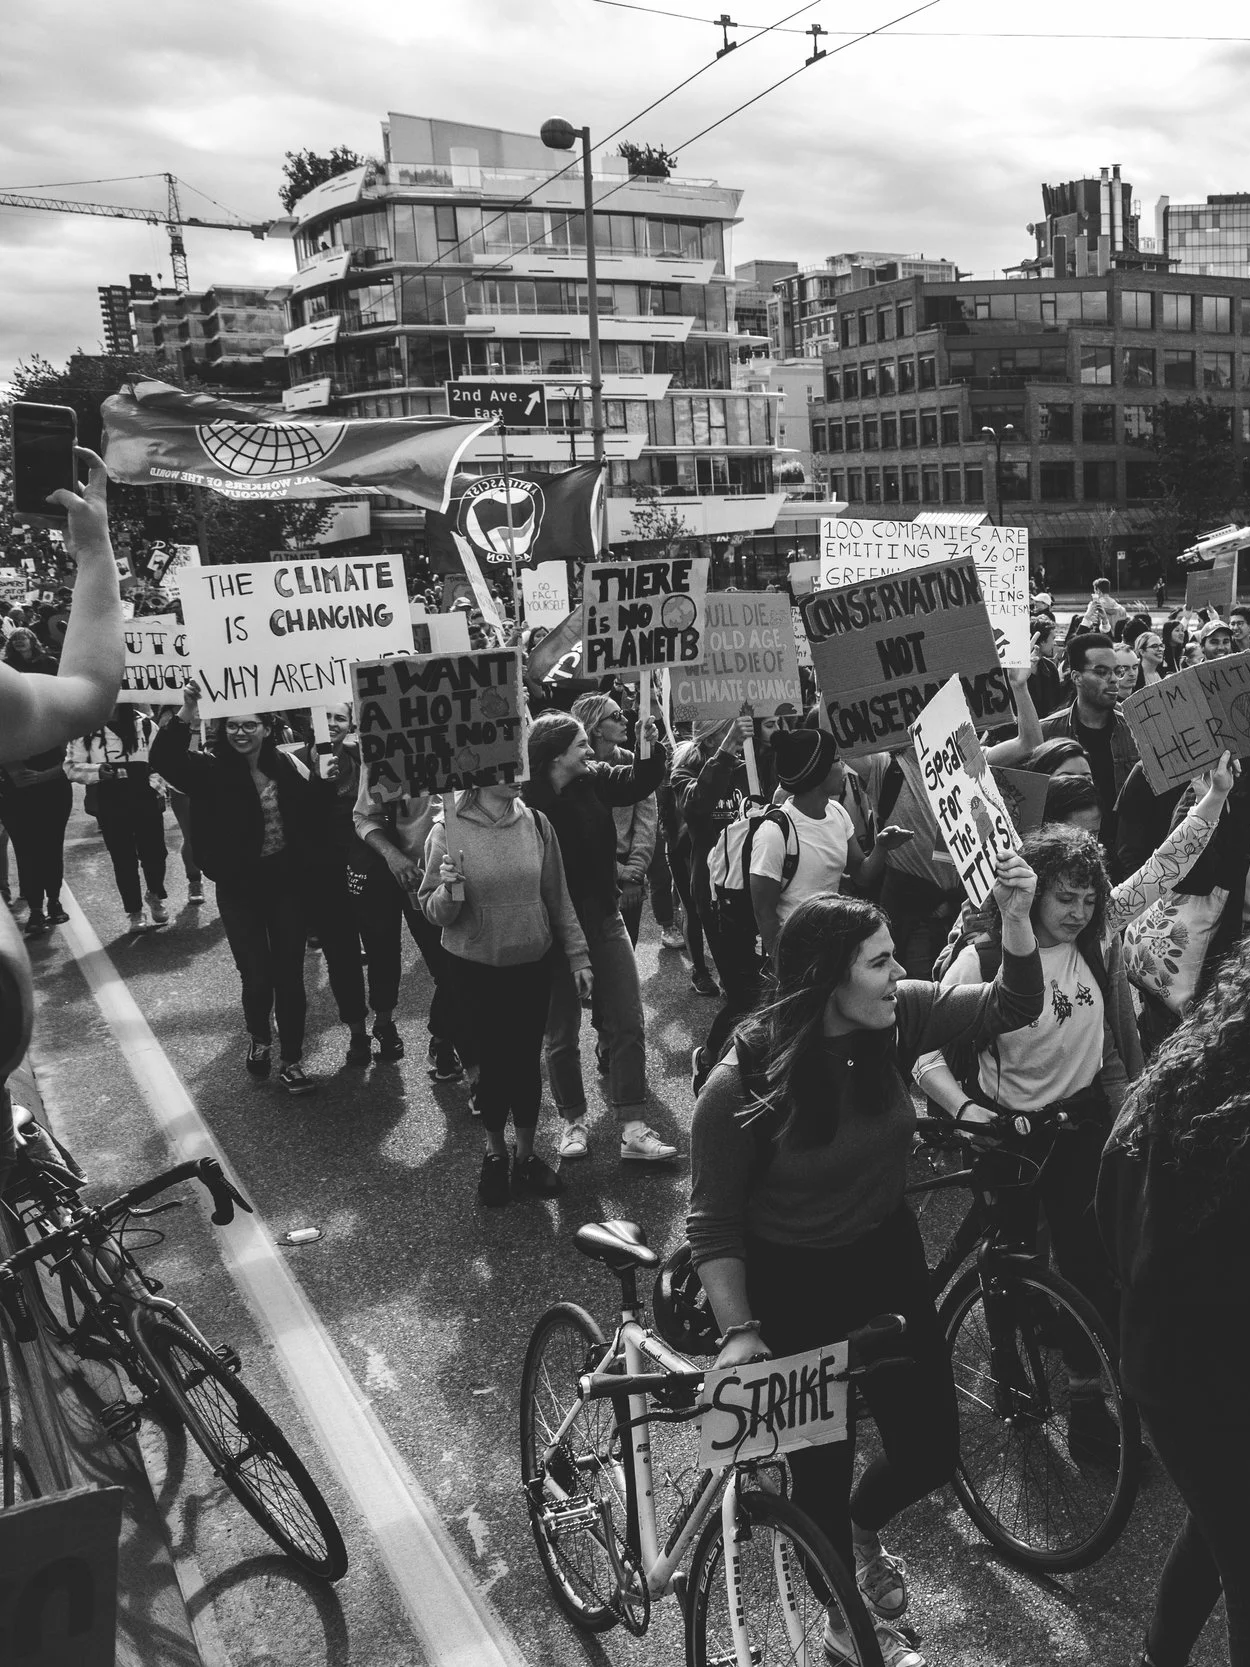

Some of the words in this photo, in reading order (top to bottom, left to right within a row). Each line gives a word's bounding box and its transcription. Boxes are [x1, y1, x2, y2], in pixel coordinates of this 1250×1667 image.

[452, 389, 482, 402] 2nd
[490, 390, 523, 402] Ave.
[474, 407, 504, 419] East
[824, 520, 864, 540] 100
[872, 521, 981, 544] COMPANIES
[991, 527, 1028, 545] ARE
[825, 542, 930, 559] EMITTING
[1002, 547, 1026, 563] OF
[201, 573, 254, 600] THE
[274, 561, 394, 598] CLIMATE
[532, 590, 559, 600] FACT
[537, 582, 551, 591] GO
[591, 559, 693, 603] THERE
[982, 589, 1025, 603] LLING
[225, 615, 248, 644] IS
[269, 603, 394, 637] CHANGING
[526, 600, 566, 612] YOURSELF
[618, 603, 654, 632] NO
[743, 602, 770, 627] DIE
[798, 565, 985, 644] CONSERVATION
[987, 604, 1031, 617] IALISM
[123, 631, 168, 655] UT
[587, 627, 679, 673] PLANET
[680, 626, 700, 662] B
[710, 629, 746, 652] OLD
[749, 628, 789, 651] AGE,
[875, 630, 928, 681] NOT
[198, 664, 259, 703] WHY
[269, 655, 348, 697] AREN'T
[356, 665, 387, 698] I
[391, 651, 516, 696] WANT
[735, 651, 762, 673] DIE
[763, 650, 785, 673] OF
[677, 679, 745, 703] CLIMATE
[748, 679, 801, 701] CHANGE
[1134, 685, 1188, 724] I'M
[359, 701, 393, 733] A
[399, 689, 478, 728] HOT
[360, 725, 455, 763] DATE
[455, 717, 522, 748] NOT
[913, 722, 930, 760] I
[1152, 717, 1238, 772] HER
[368, 759, 402, 787] A
[409, 761, 519, 799] PLANET
[938, 783, 962, 833] for
[948, 822, 976, 863] The
[711, 1354, 836, 1451] STRIKE
[699, 1534, 724, 1594] EAST
